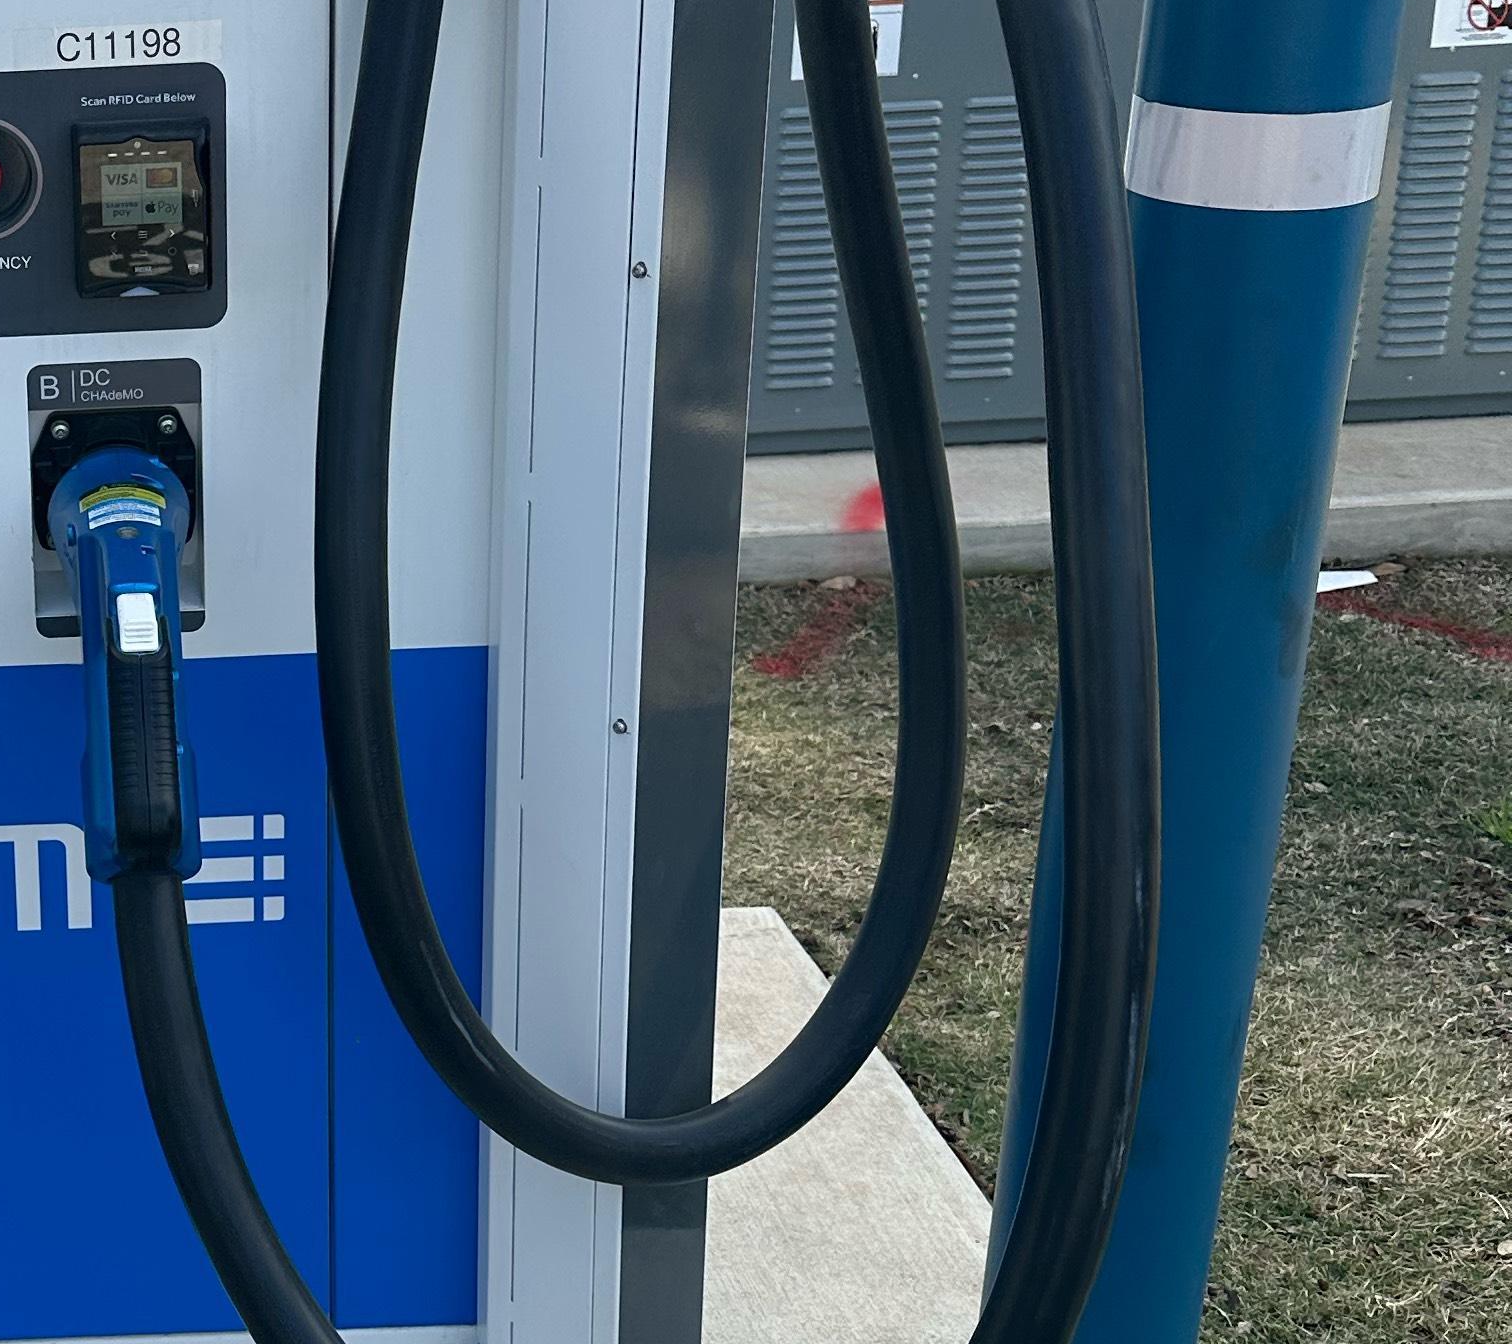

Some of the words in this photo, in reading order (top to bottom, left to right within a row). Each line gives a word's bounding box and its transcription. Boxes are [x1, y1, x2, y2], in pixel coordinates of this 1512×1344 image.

[56, 27, 182, 62] C11198
[80, 96, 107, 107] Scan
[109, 94, 134, 105] RFID
[135, 93, 162, 104] Card
[163, 92, 197, 103] Below
[104, 174, 138, 186] VISA
[157, 201, 179, 215] Pay
[39, 375, 60, 400] B
[79, 368, 111, 387] DC
[80, 388, 144, 402] CHAdeMO
